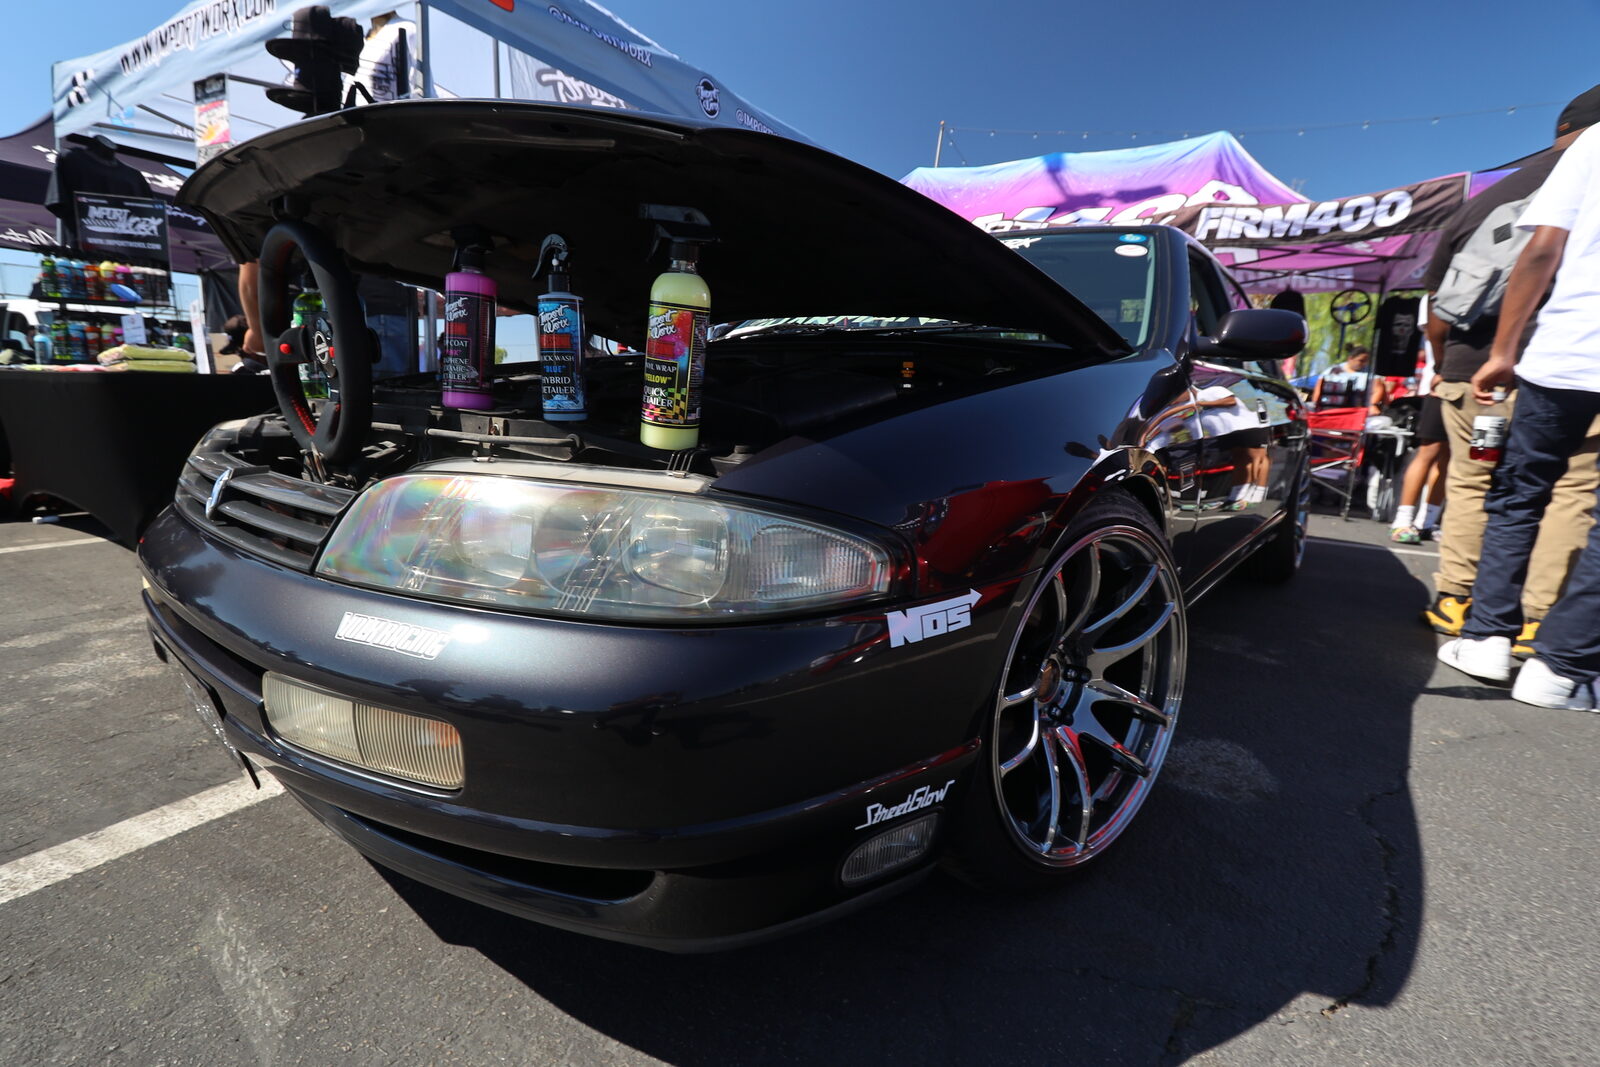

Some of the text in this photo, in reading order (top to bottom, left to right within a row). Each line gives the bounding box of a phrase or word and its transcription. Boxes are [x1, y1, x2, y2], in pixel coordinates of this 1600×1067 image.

[1196, 190, 1412, 240] FIRM400
[539, 304, 569, 326] Import
[543, 318, 569, 334] Worx
[650, 324, 677, 339] Worx
[656, 363, 677, 374] WRAP
[542, 386, 575, 394] ETAILER
[643, 385, 667, 397] QUICK
[642, 395, 673, 408] ETAILER
[854, 780, 956, 830] StreetGlow
